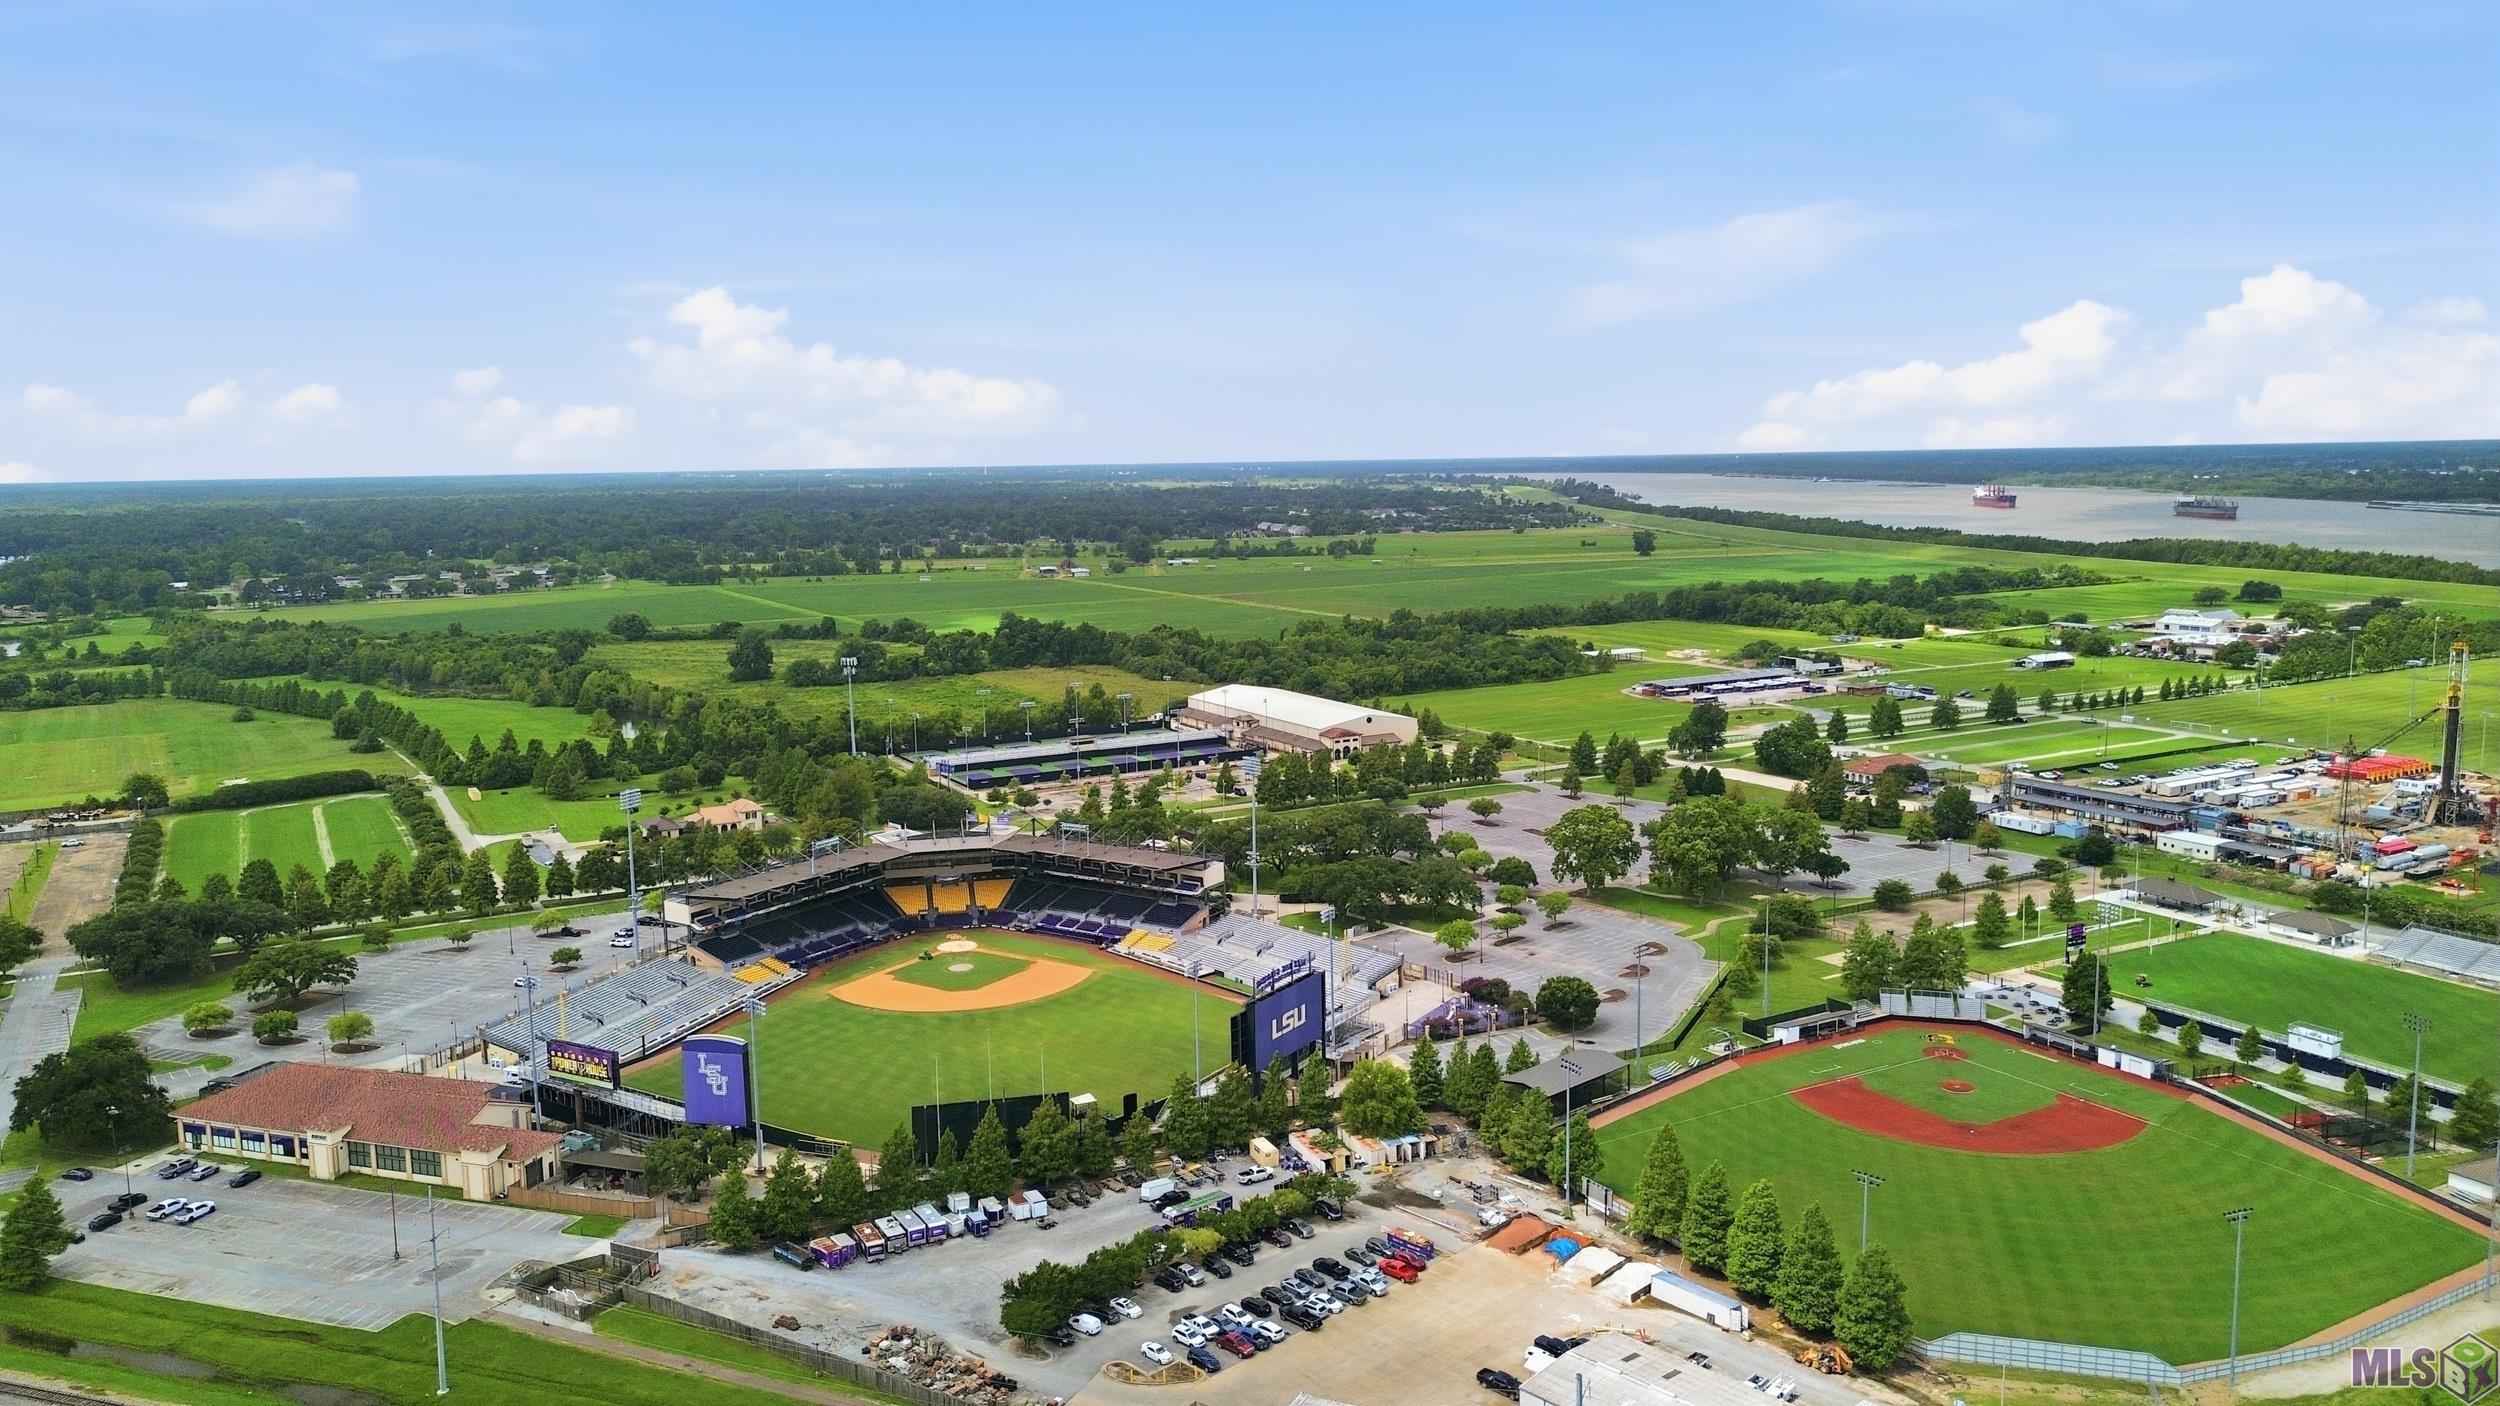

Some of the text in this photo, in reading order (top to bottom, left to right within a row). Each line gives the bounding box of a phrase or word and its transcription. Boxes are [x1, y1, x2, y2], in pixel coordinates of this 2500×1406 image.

[1272, 1004, 1306, 1040] LSU
[556, 1056, 577, 1072] POWER
[698, 1052, 728, 1095] LSU
